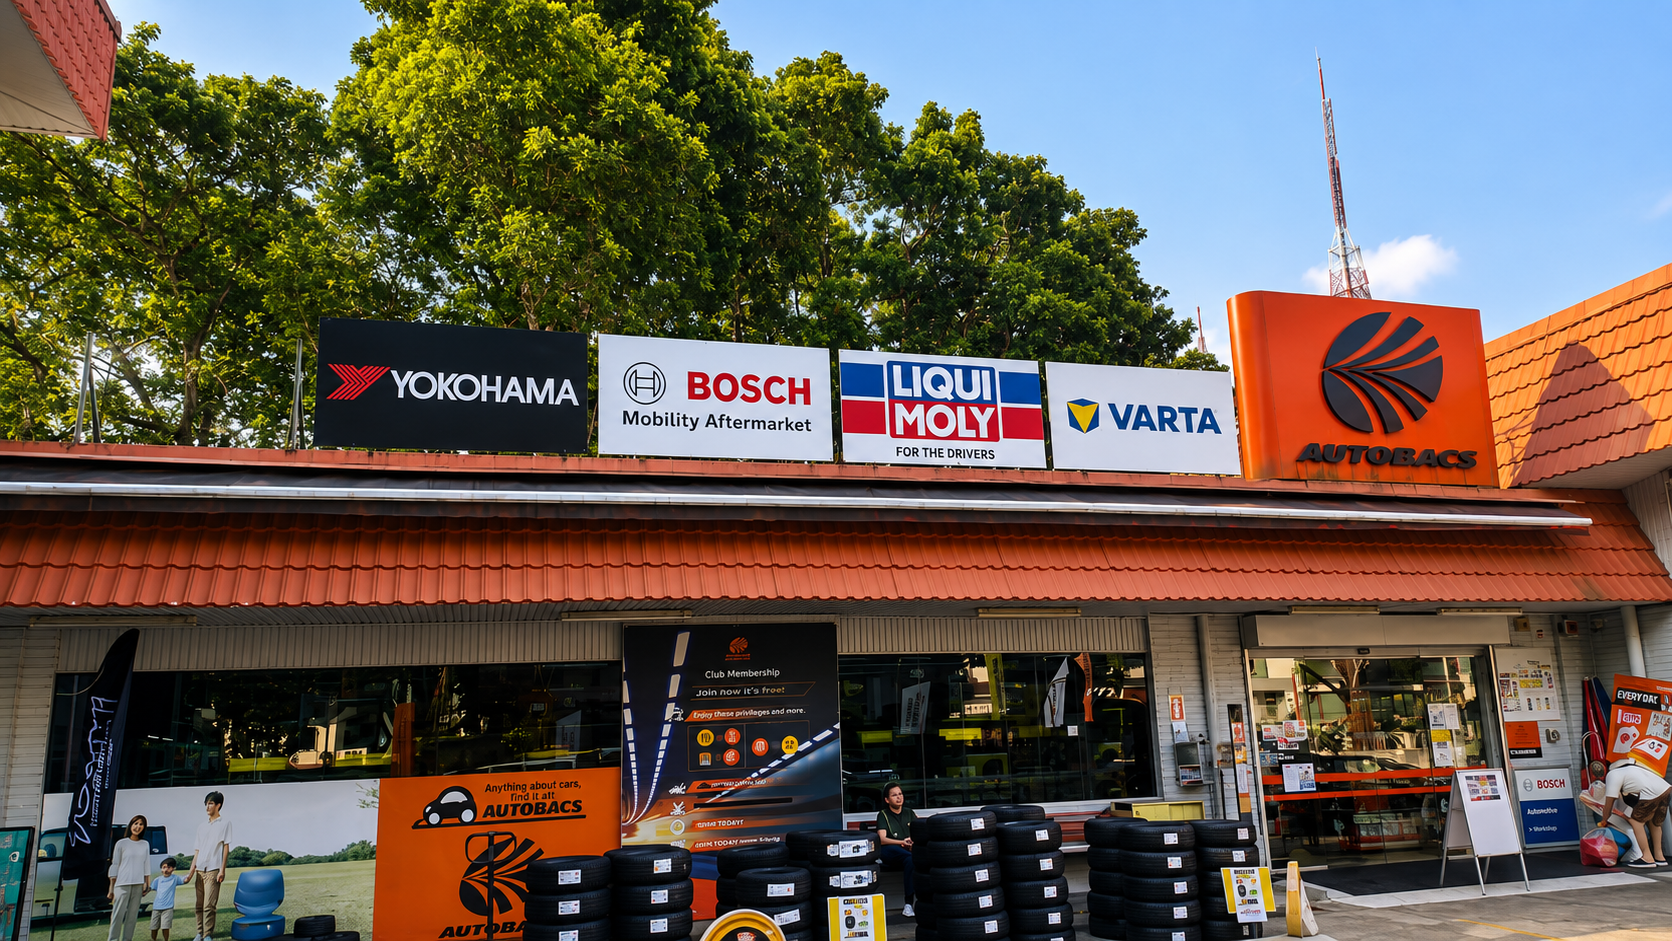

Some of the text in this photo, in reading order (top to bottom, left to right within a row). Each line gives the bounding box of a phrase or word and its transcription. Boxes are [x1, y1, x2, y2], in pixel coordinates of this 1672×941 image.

[391, 370, 579, 406] YOKOHAMA
[687, 371, 811, 405] BOSCH
[893, 365, 992, 401] LIQUI
[622, 410, 811, 431] Mobility Aftermarket
[894, 403, 996, 438] MOLY
[1107, 403, 1222, 434] VARTA
[896, 447, 995, 460] FOR THE DRIVERS
[1295, 443, 1477, 469] AUTOBACS
[705, 668, 780, 679] Club Membership
[696, 688, 717, 697] Join
[484, 780, 581, 794] Anything about cars,
[1537, 779, 1566, 789] BOSCH
[482, 800, 583, 818] AUTOBACS
[438, 921, 525, 938] AUTOBA
